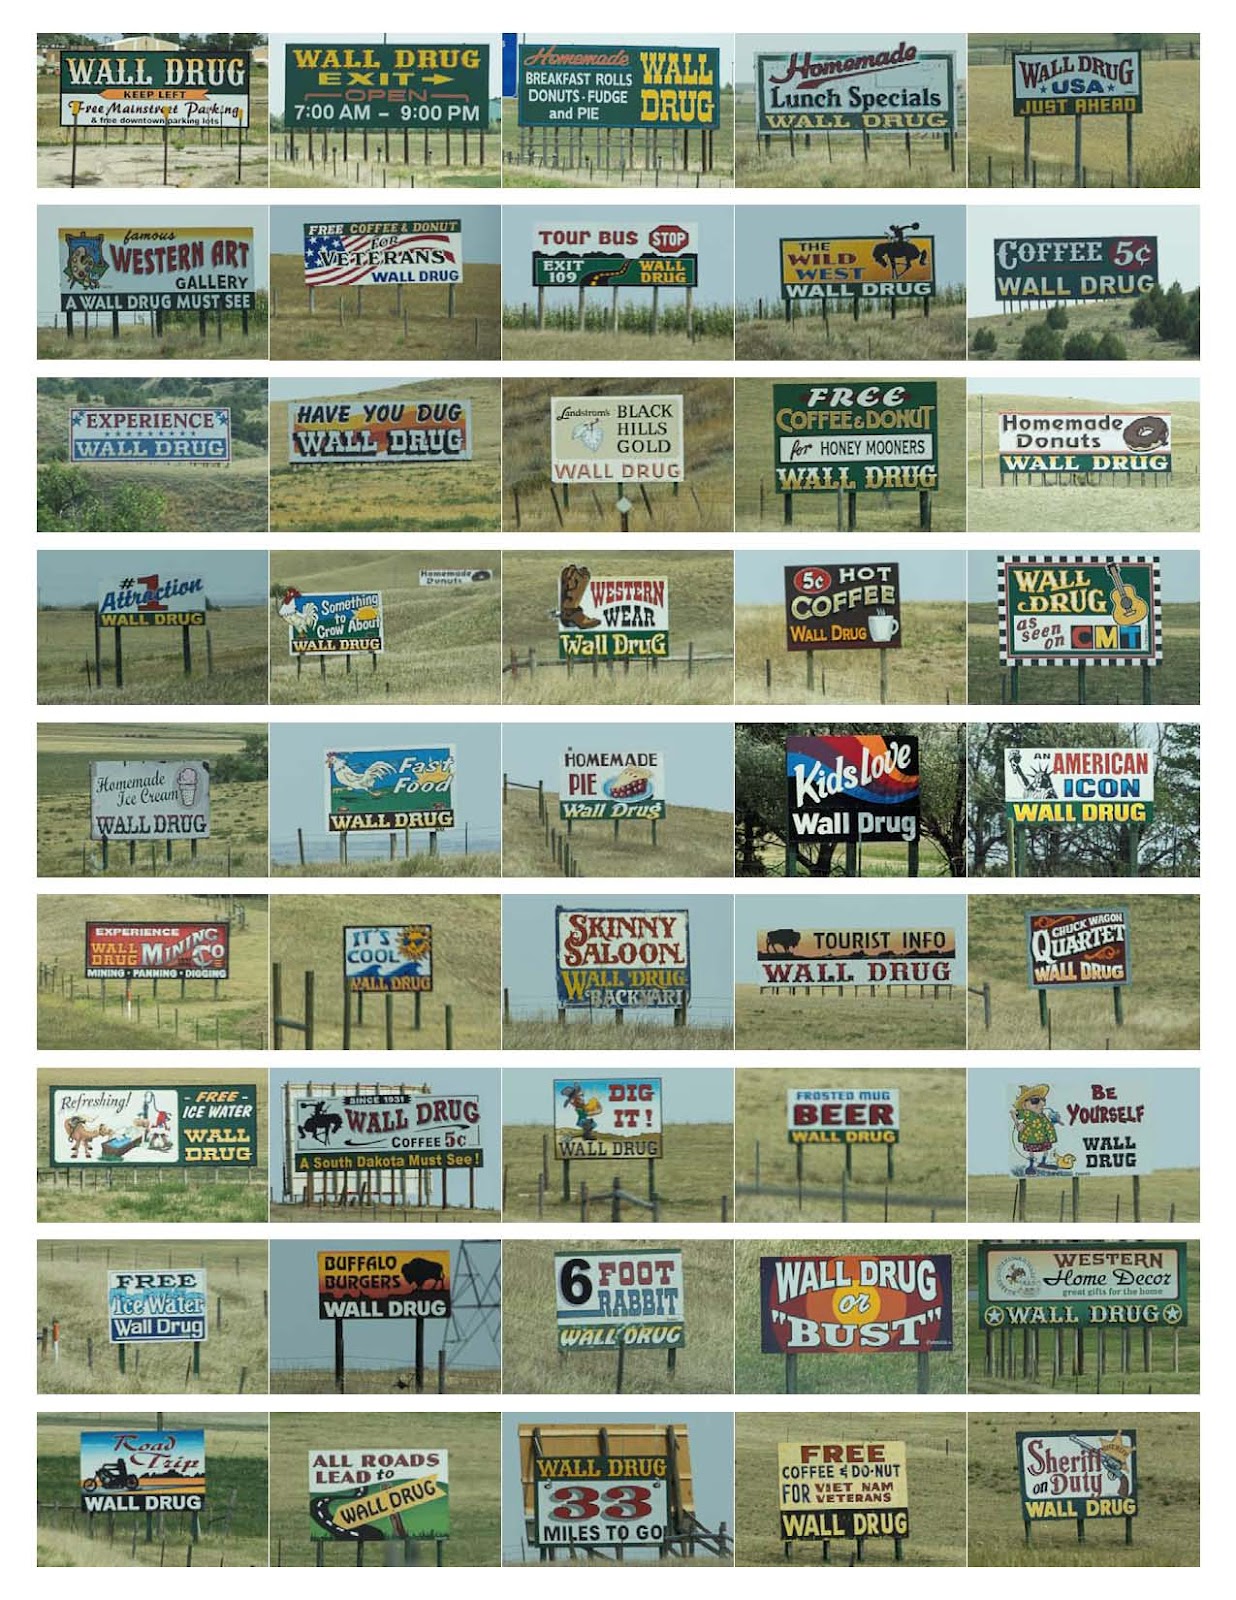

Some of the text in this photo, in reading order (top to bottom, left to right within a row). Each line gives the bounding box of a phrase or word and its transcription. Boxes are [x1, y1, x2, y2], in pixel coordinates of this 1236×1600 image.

[67, 58, 245, 86] WALL DRUG
[641, 52, 713, 86] WALL
[770, 41, 918, 84] Homemade
[1020, 55, 1133, 89] WALL DRUG
[319, 72, 415, 86] EXIT
[1053, 79, 1105, 94] USA
[124, 91, 187, 99] KEEP LEFT
[346, 90, 428, 102] OPEN
[772, 86, 941, 111] Lunch Specials
[295, 105, 480, 121] 7:00 AM 9:00 PM
[549, 107, 599, 120] and PIE
[642, 89, 715, 123] DRUG
[100, 117, 117, 125] free
[121, 117, 165, 125] downtown
[168, 117, 199, 127] parking
[203, 117, 219, 125] lots
[767, 113, 948, 128] WALL DRUG
[800, 242, 830, 252] THE
[997, 240, 1151, 271] COFFEE 5¢
[110, 240, 250, 276] WESTERN ART
[322, 249, 446, 268] VETERANS
[544, 260, 585, 272] EXIT
[788, 253, 857, 266] WILD
[373, 270, 460, 283] WALL DRUG
[549, 272, 577, 284] 109
[998, 274, 1154, 297] WALL DRUG
[65, 295, 250, 310] A WALL DRUG MUST SEE
[808, 387, 906, 407] FREE
[299, 404, 462, 423] HAVE YOU DUG
[618, 404, 674, 418] BLACK
[87, 413, 214, 429] EXPERIENCE
[618, 422, 667, 435] HILLS
[1003, 414, 1123, 431] Homemade
[77, 440, 225, 457] WALL DRUG
[294, 429, 463, 456] WALL DRUG
[1017, 433, 1101, 448] Donuts
[777, 465, 937, 490] WALL DRUG
[841, 567, 891, 584] HOT
[102, 578, 204, 613] Attraction
[591, 580, 664, 609] WESTERN
[792, 585, 896, 620] COFFEE
[322, 593, 379, 616] Something
[102, 612, 203, 626] WALL DRUG
[334, 612, 346, 625] to
[604, 605, 655, 628] WEAR
[1017, 617, 1037, 631] as
[1071, 625, 1141, 650] CMT
[399, 757, 454, 774] Fast
[566, 752, 658, 767] HOMEMADE
[1054, 752, 1149, 775] AMERICAN
[98, 770, 167, 793] Homemade
[794, 740, 911, 808] Kids Love
[394, 774, 452, 794] Food
[563, 801, 661, 820] Wall Drug
[1014, 802, 1147, 822] WALL DRUG
[97, 814, 207, 834] WALL DRUG
[793, 811, 917, 842] Wall Drug
[97, 928, 180, 937] EXPERIENCE
[568, 915, 677, 947] SKINNY
[1053, 913, 1122, 938] CHUCK WAGON
[354, 928, 391, 947] IT'S
[814, 931, 946, 950] TOURIST INFO
[1032, 924, 1126, 964] QUARTET
[348, 950, 401, 964] COOL
[565, 937, 685, 967] SALOON
[88, 970, 226, 978] MINING PANNING DIGGING
[763, 961, 951, 983] WALL DRUG
[196, 1091, 240, 1102] FREE
[350, 1096, 379, 1105] SINCE
[609, 1084, 655, 1102] DIG
[182, 1104, 253, 1119] ICE WATER
[345, 1099, 480, 1134] WALL DRUG
[795, 1104, 894, 1126] BEER
[1067, 1103, 1145, 1126] YOURSELF
[793, 1130, 895, 1142] WALL DRUG
[558, 1141, 658, 1157] WALL DRUG
[325, 1256, 398, 1271] BUFFALO
[1055, 1252, 1163, 1268] WESTERN
[117, 1274, 197, 1289] FREE
[325, 1275, 401, 1289] BURGERS
[562, 1258, 593, 1305] 6
[599, 1260, 675, 1286] FOOT
[1063, 1286, 1162, 1298] great gifts for the home
[114, 1295, 204, 1316] Ice Water
[839, 1292, 872, 1313] or
[771, 1307, 942, 1347] "BUST"
[112, 1434, 177, 1451] Road
[313, 1453, 440, 1468] ALL ROADS
[538, 1458, 667, 1478] WALL DRUG
[316, 1468, 395, 1485] LEAD to
[1033, 1473, 1102, 1498] on Duty
[783, 1481, 893, 1504] FOR VIET NAM
[817, 1492, 892, 1503] VETERANS
[85, 1495, 201, 1511] WALL DRUG
[549, 1485, 653, 1522] 33
[1026, 1499, 1137, 1518] WALL DRUG
